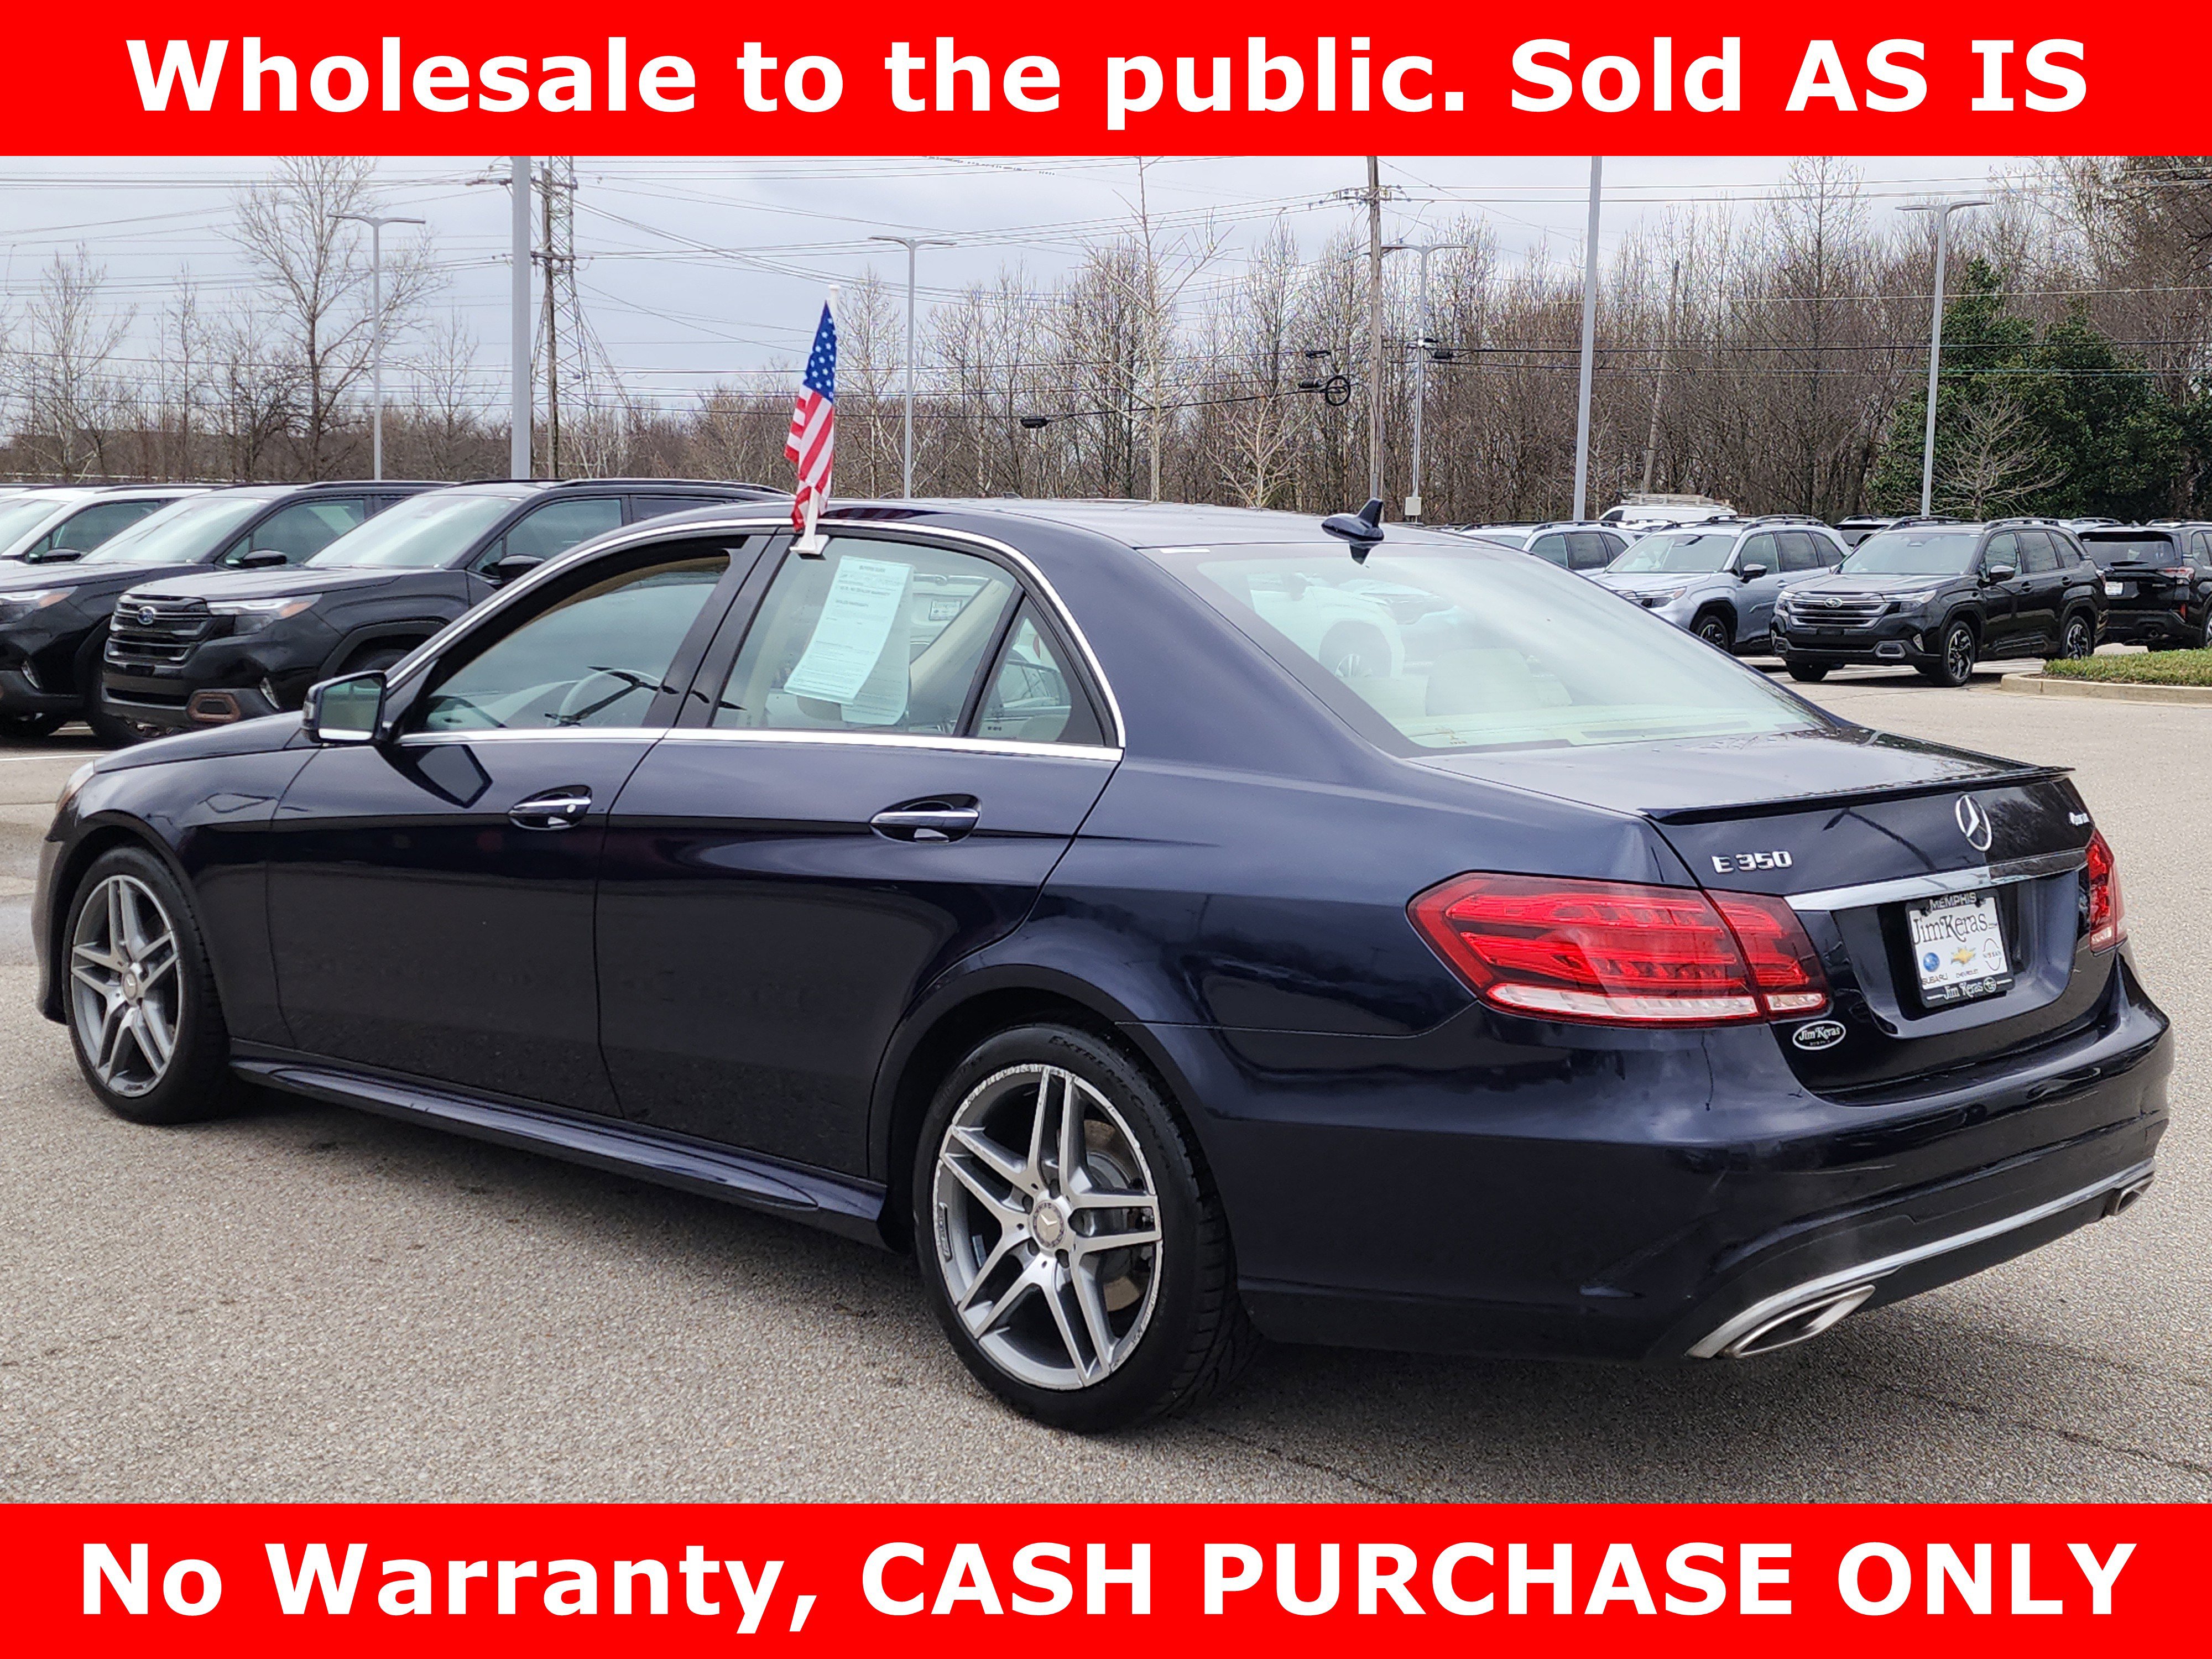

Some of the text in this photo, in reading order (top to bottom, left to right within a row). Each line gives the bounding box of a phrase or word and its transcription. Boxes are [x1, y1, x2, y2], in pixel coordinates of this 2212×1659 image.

[1712, 851, 1793, 874] E 350
[1929, 892, 1978, 911] MEMPHIS
[1943, 981, 1984, 1000] Jim Keras
